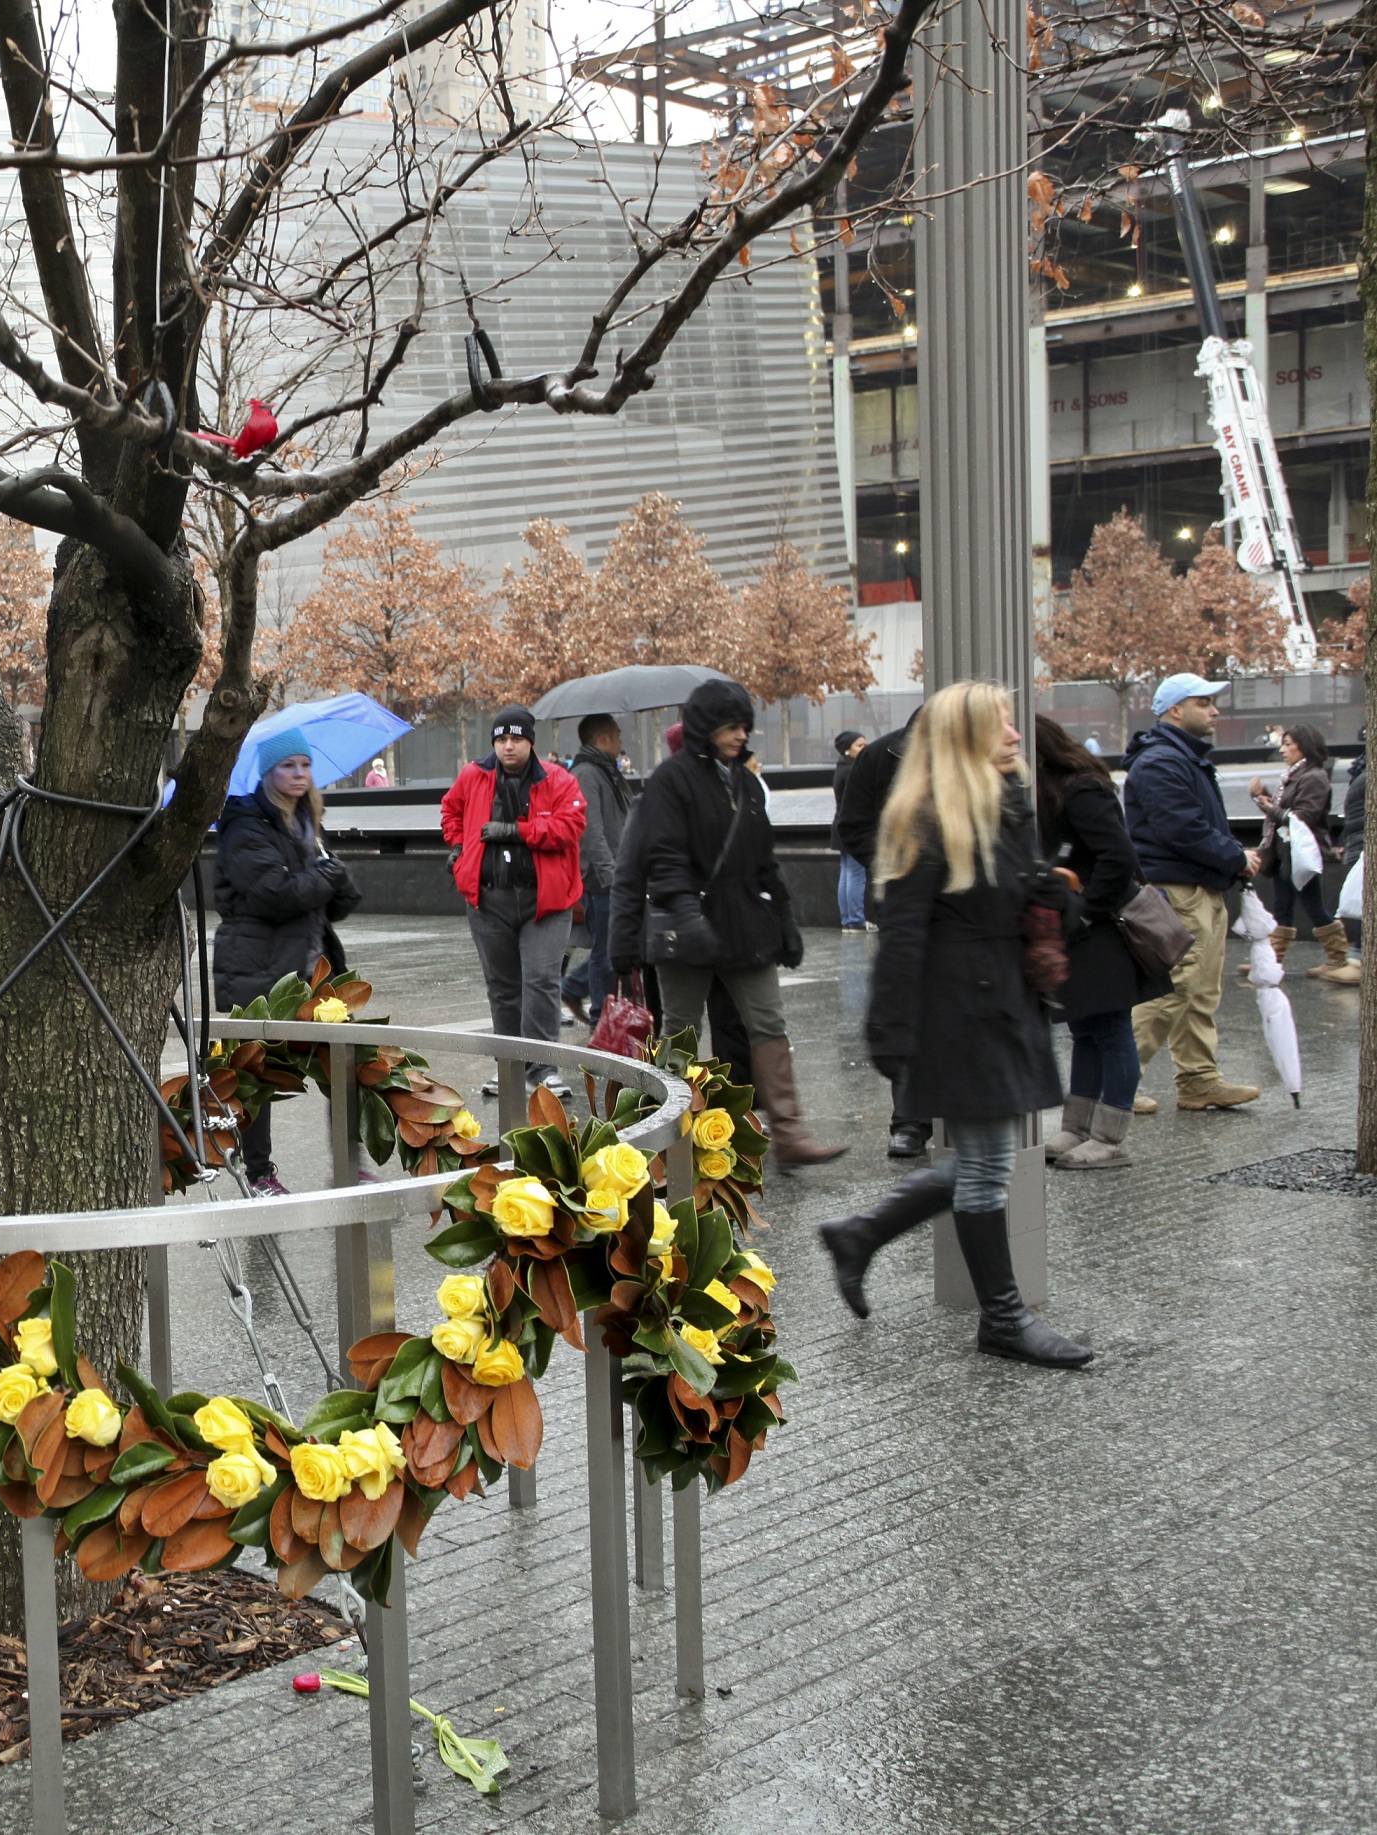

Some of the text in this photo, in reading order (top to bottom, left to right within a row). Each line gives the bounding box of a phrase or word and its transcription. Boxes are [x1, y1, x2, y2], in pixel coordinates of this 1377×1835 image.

[1276, 366, 1323, 386] SONS
[1088, 391, 1129, 409] SONS
[1222, 425, 1250, 501] BAY CRANE
[509, 725, 523, 735] YORK
